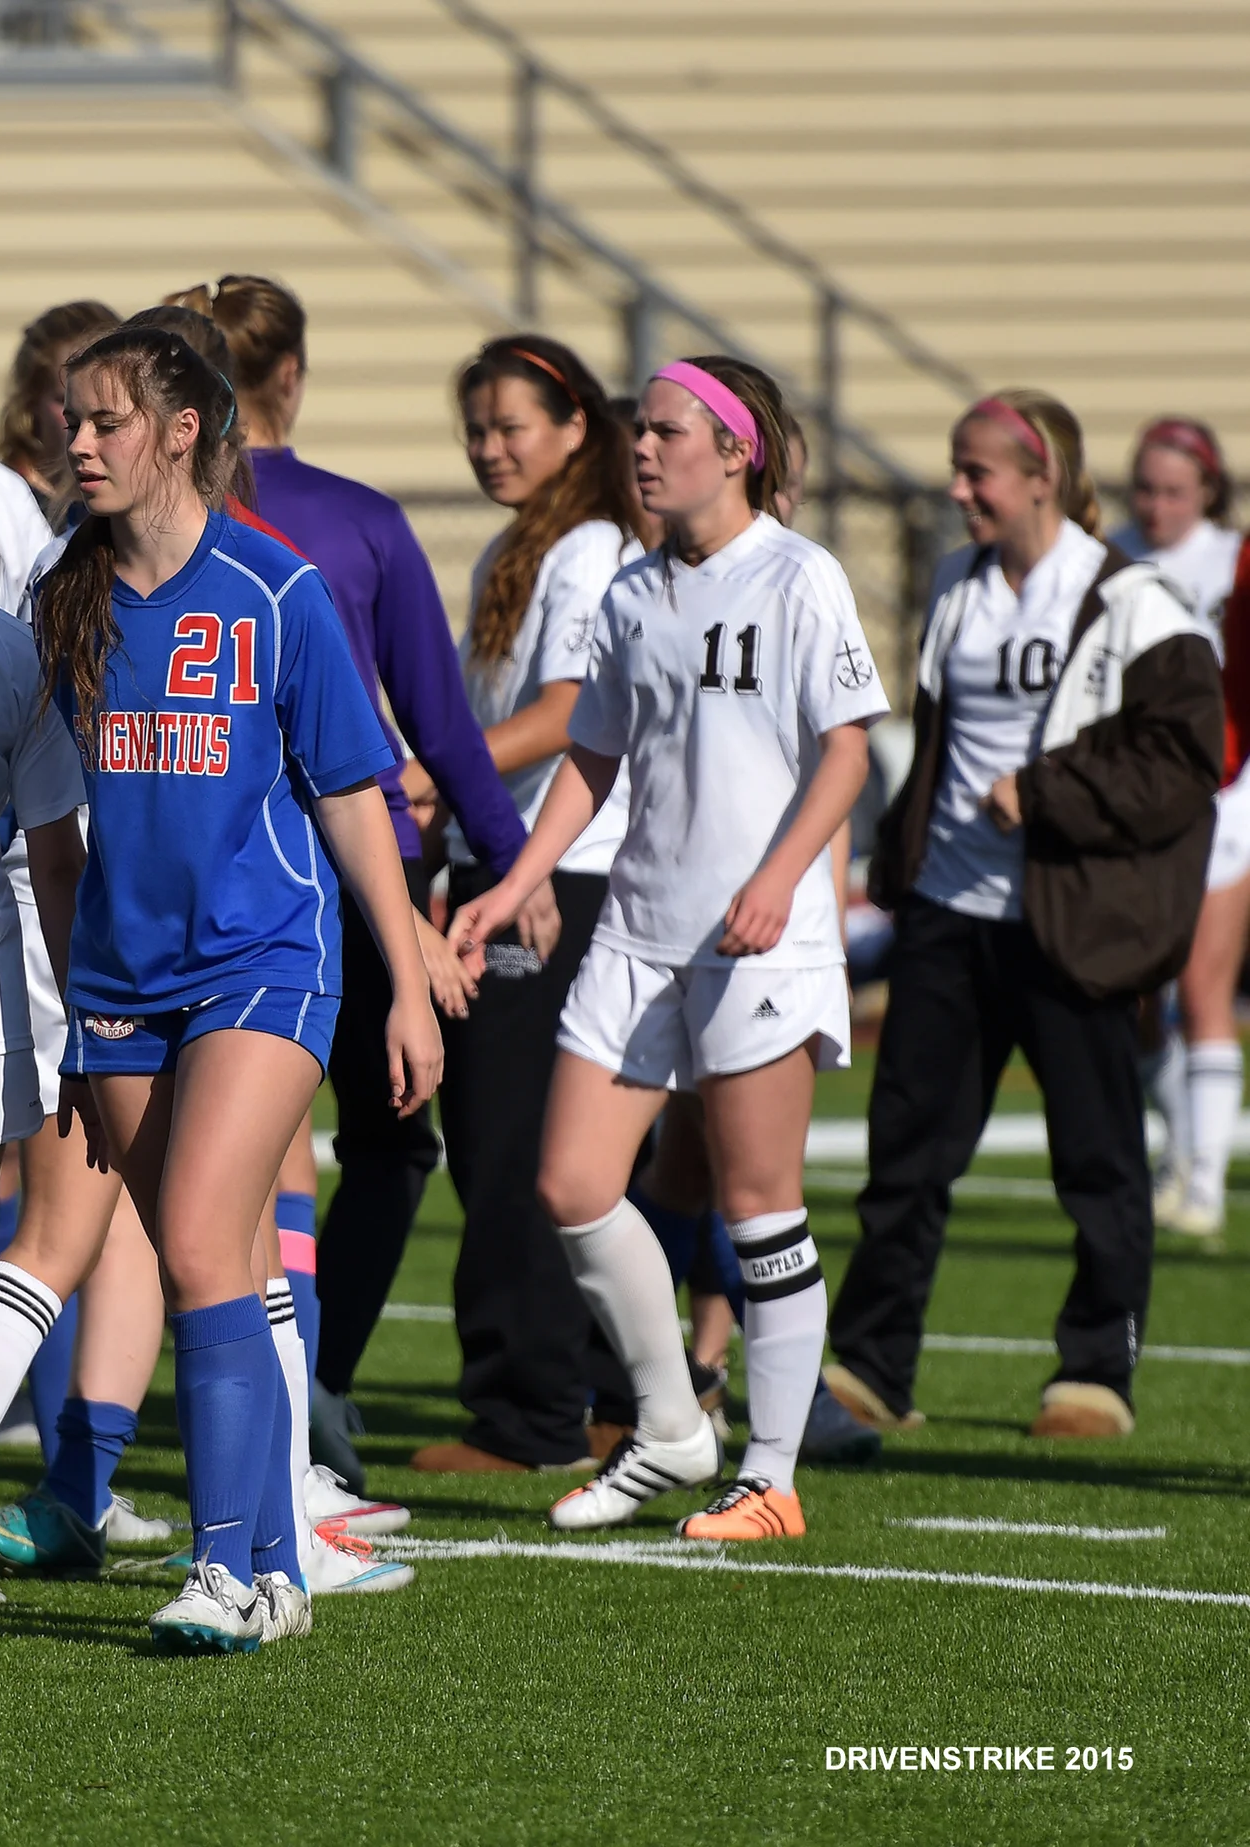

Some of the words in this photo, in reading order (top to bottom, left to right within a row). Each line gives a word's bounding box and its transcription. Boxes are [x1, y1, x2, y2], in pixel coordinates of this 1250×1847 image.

[165, 612, 260, 704] 21
[699, 620, 762, 696] 11
[994, 637, 1058, 694] 10
[99, 711, 232, 777] IGNATIUS
[95, 1022, 133, 1038] WILDCATS
[752, 1248, 805, 1278] CAPTAIN
